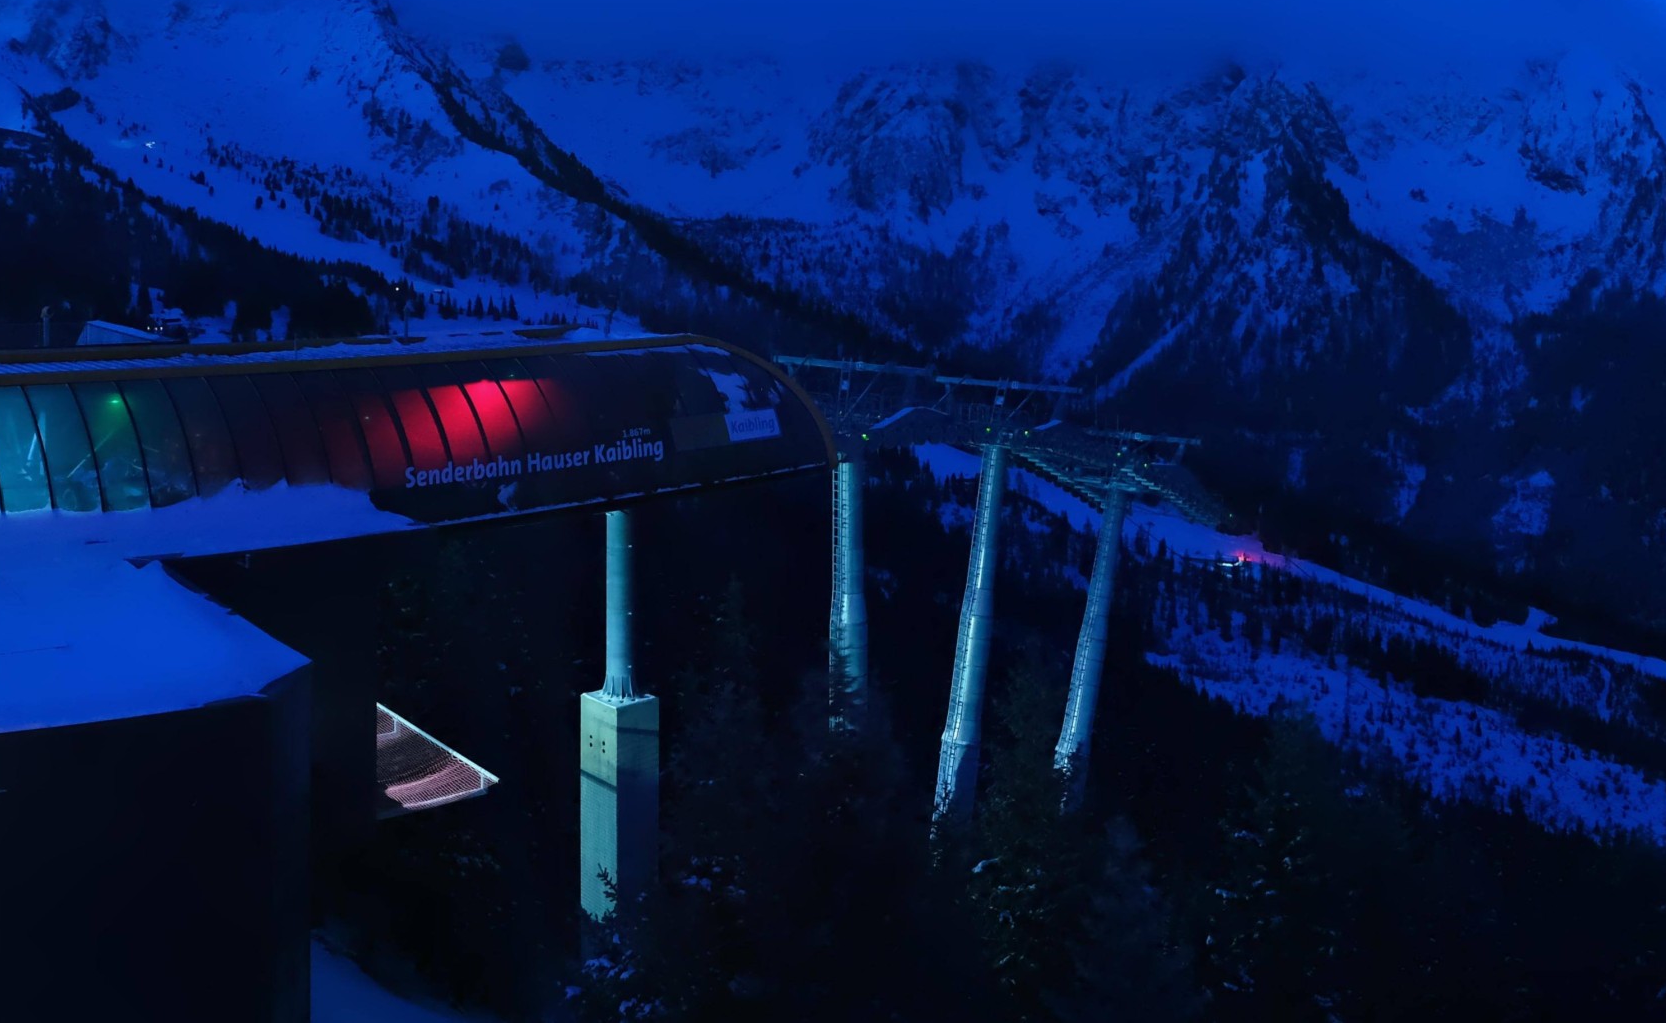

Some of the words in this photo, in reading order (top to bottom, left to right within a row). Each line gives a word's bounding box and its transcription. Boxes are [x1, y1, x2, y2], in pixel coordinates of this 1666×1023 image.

[730, 416, 775, 434] Kaibling
[404, 455, 522, 489] Senderbahn
[526, 449, 590, 473] Hauser
[593, 437, 665, 463] Kaibling
